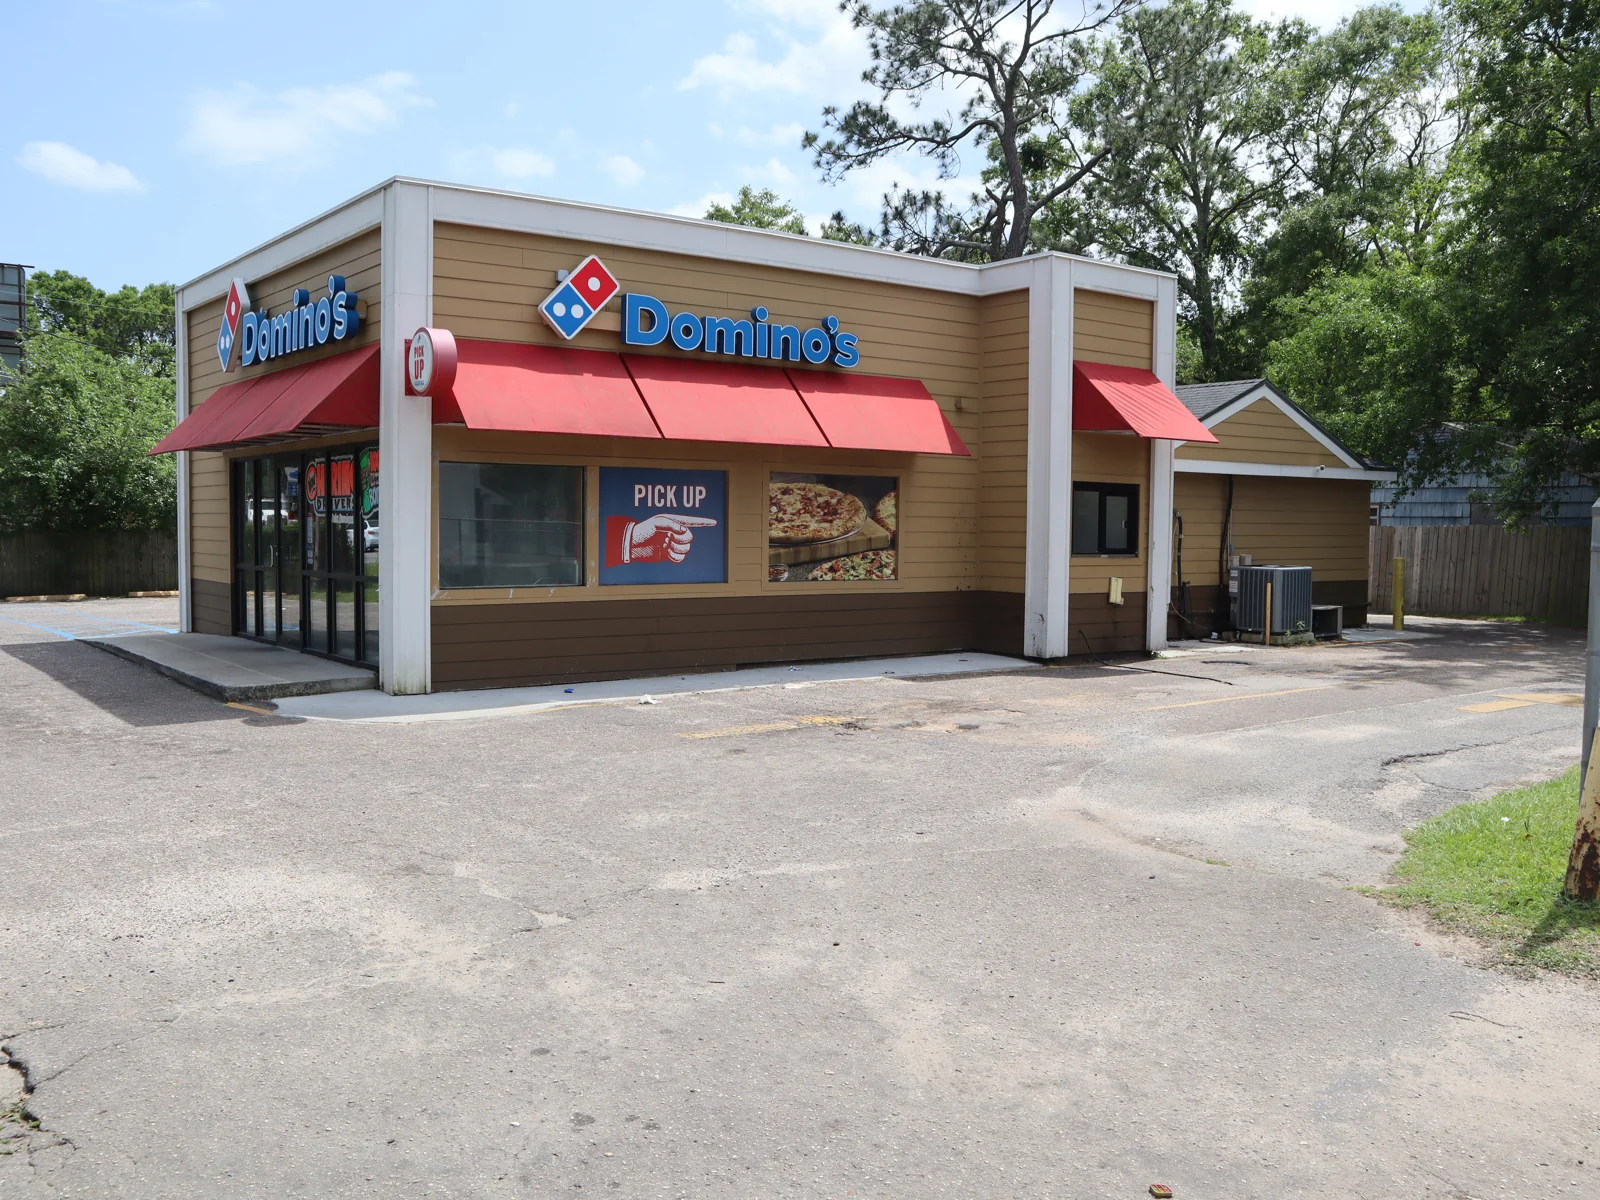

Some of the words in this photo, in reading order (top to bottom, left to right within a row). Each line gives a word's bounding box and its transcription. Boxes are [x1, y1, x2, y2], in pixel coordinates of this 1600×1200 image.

[242, 275, 354, 367] Domino's
[621, 292, 860, 367] Domino's
[414, 345, 425, 359] PICK
[414, 358, 425, 380] UP
[634, 484, 678, 508] PICK
[683, 485, 707, 508] UP
